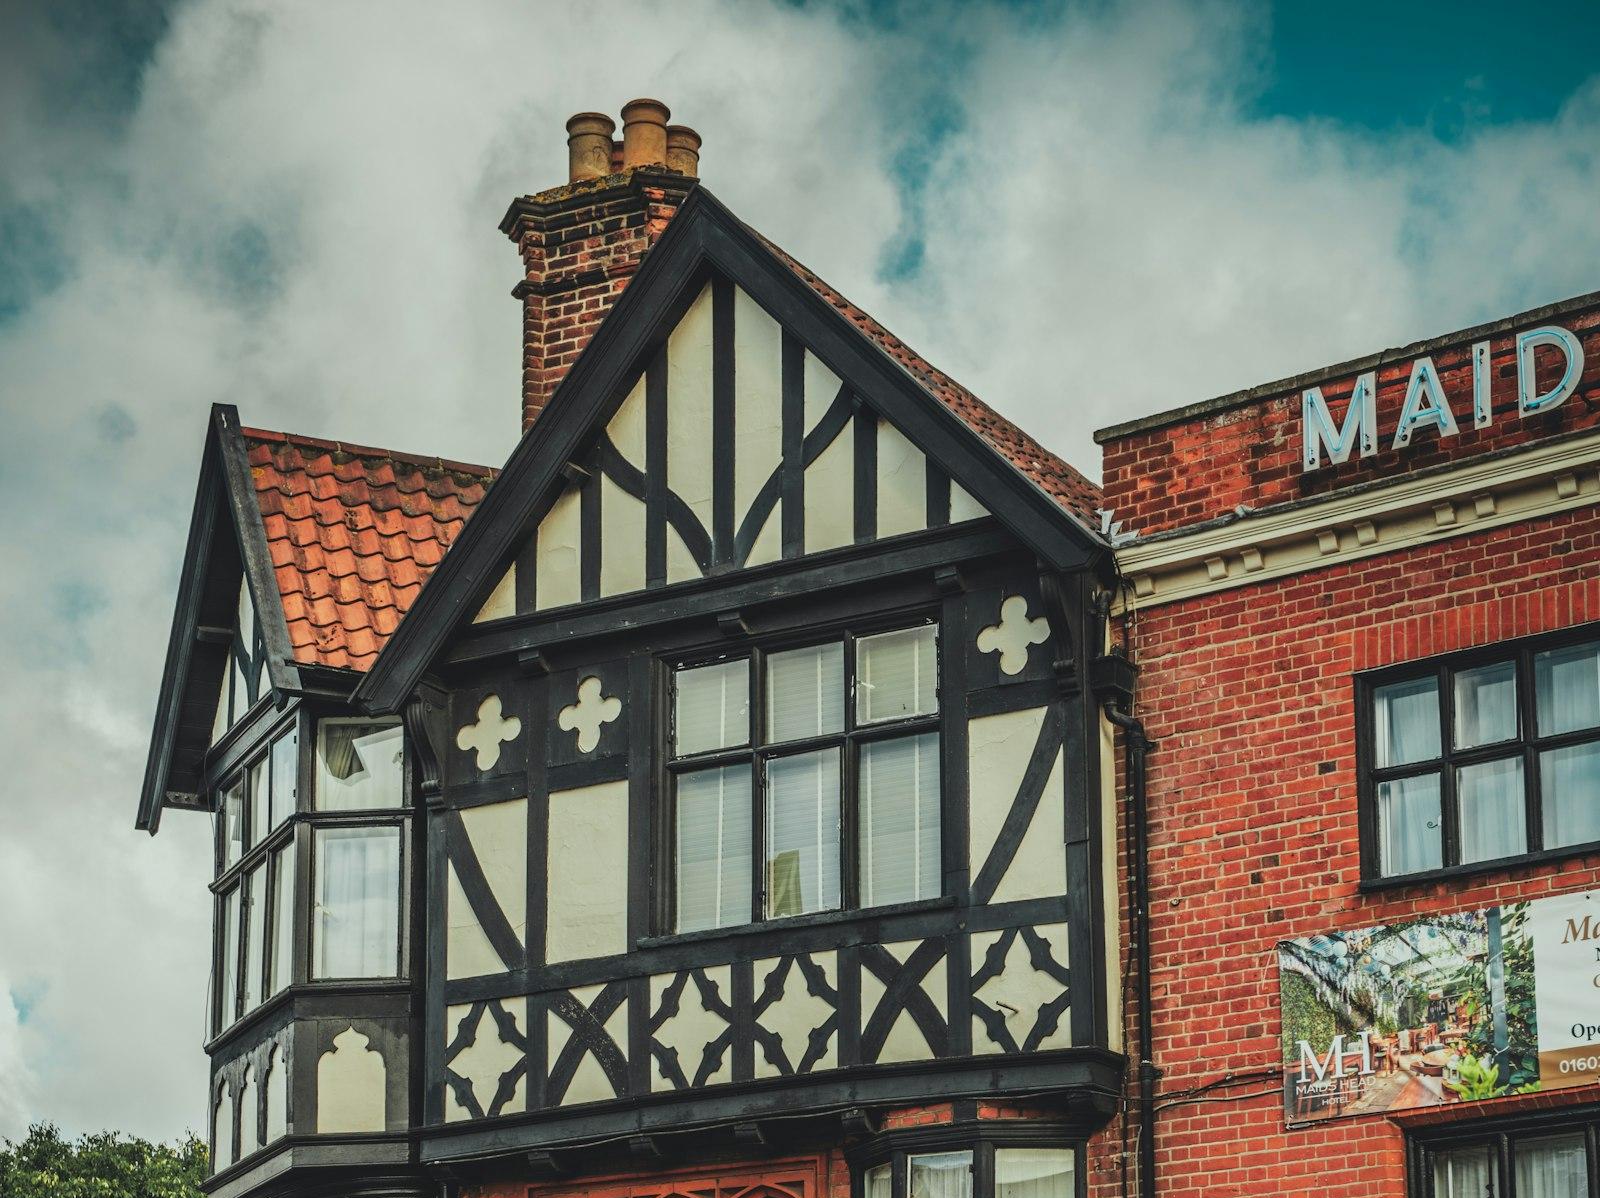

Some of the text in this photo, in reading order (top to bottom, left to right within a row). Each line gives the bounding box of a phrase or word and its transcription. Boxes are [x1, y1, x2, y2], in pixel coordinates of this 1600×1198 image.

[1302, 326, 1584, 472] MAID
[1296, 1075, 1376, 1095] MAIDS HEAD
[1322, 1096, 1351, 1106] HOTEL
